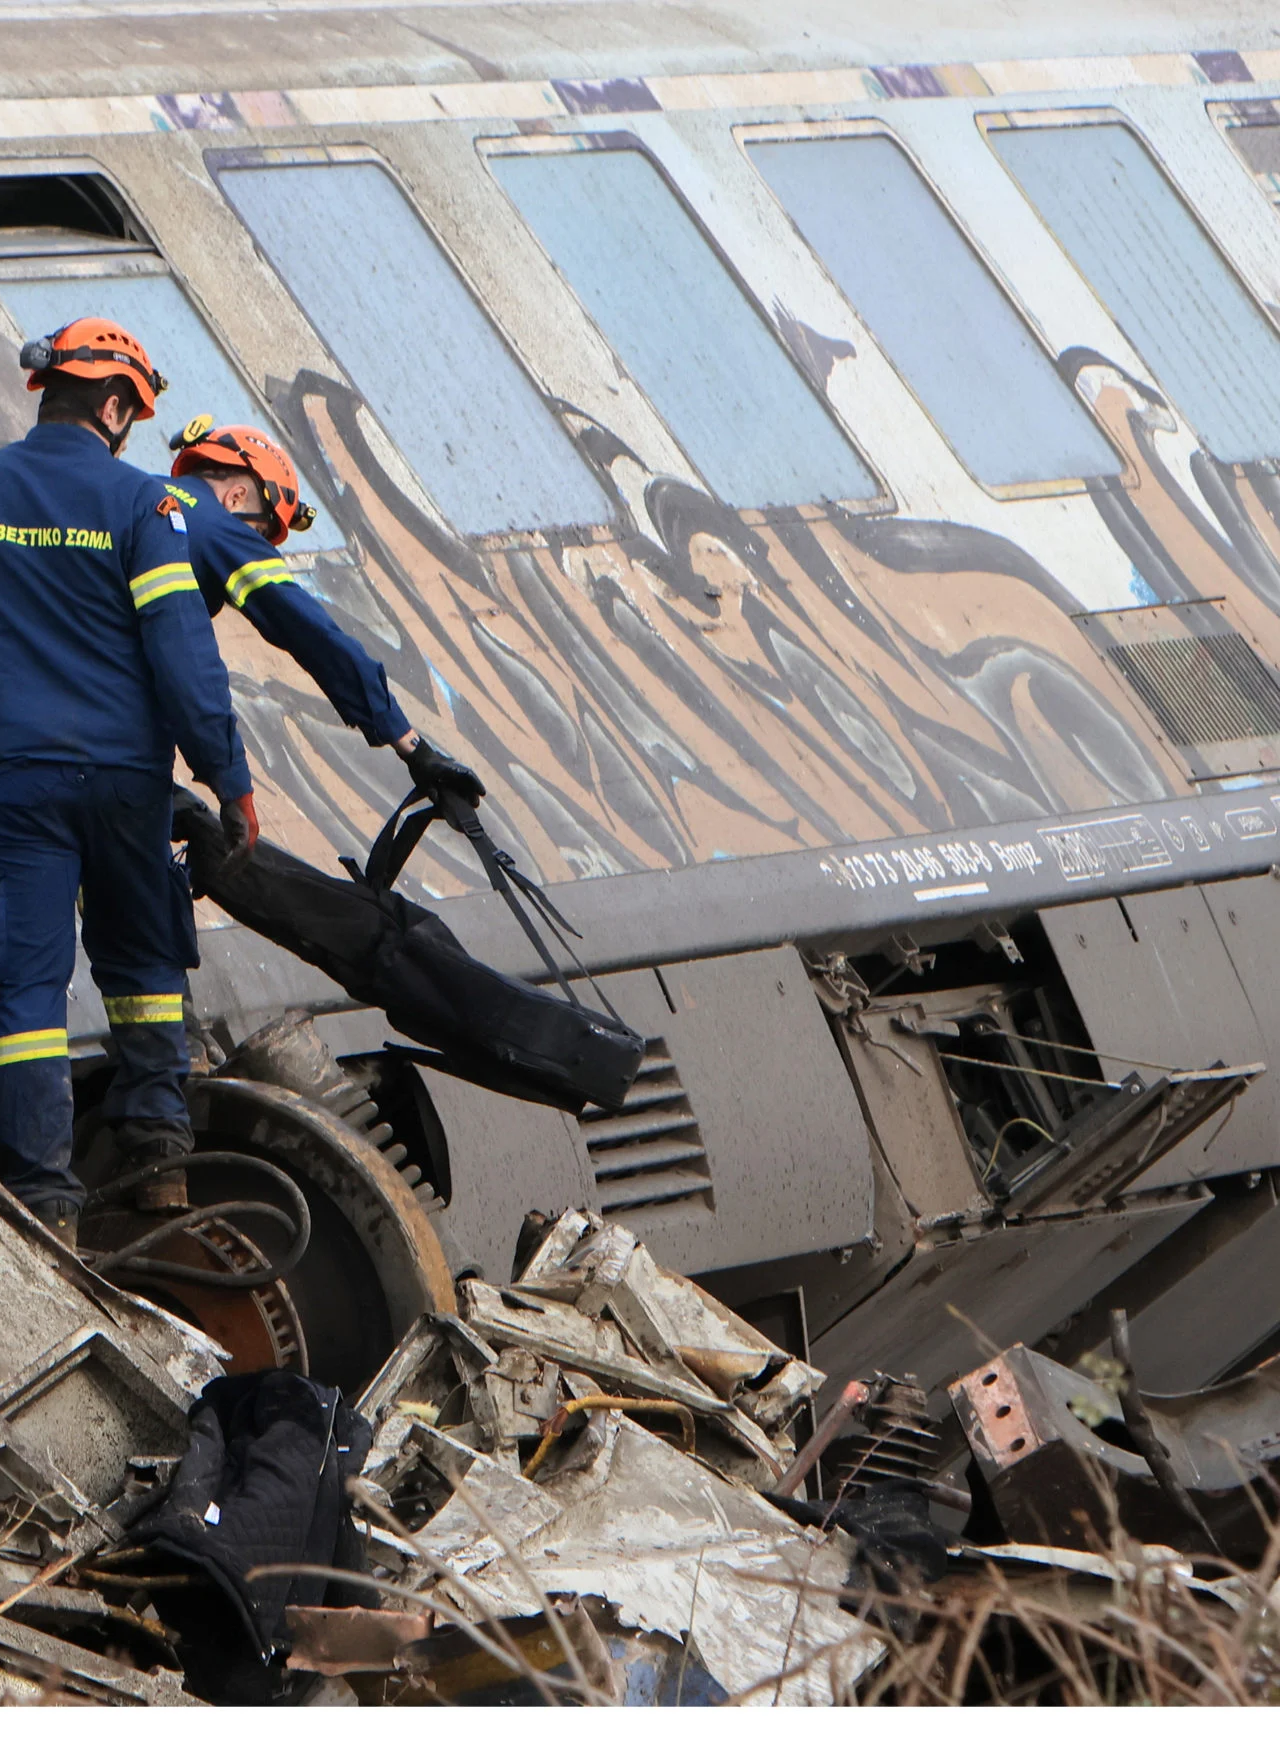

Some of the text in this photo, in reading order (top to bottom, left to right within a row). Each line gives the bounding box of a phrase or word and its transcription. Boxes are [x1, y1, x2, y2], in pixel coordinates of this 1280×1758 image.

[164, 483, 198, 508] ΩΜΑ
[65, 528, 113, 550] ΣΩΜΑ
[891, 846, 946, 883] 20-96
[937, 840, 993, 876] 503-8
[989, 840, 1043, 876] Bmpz
